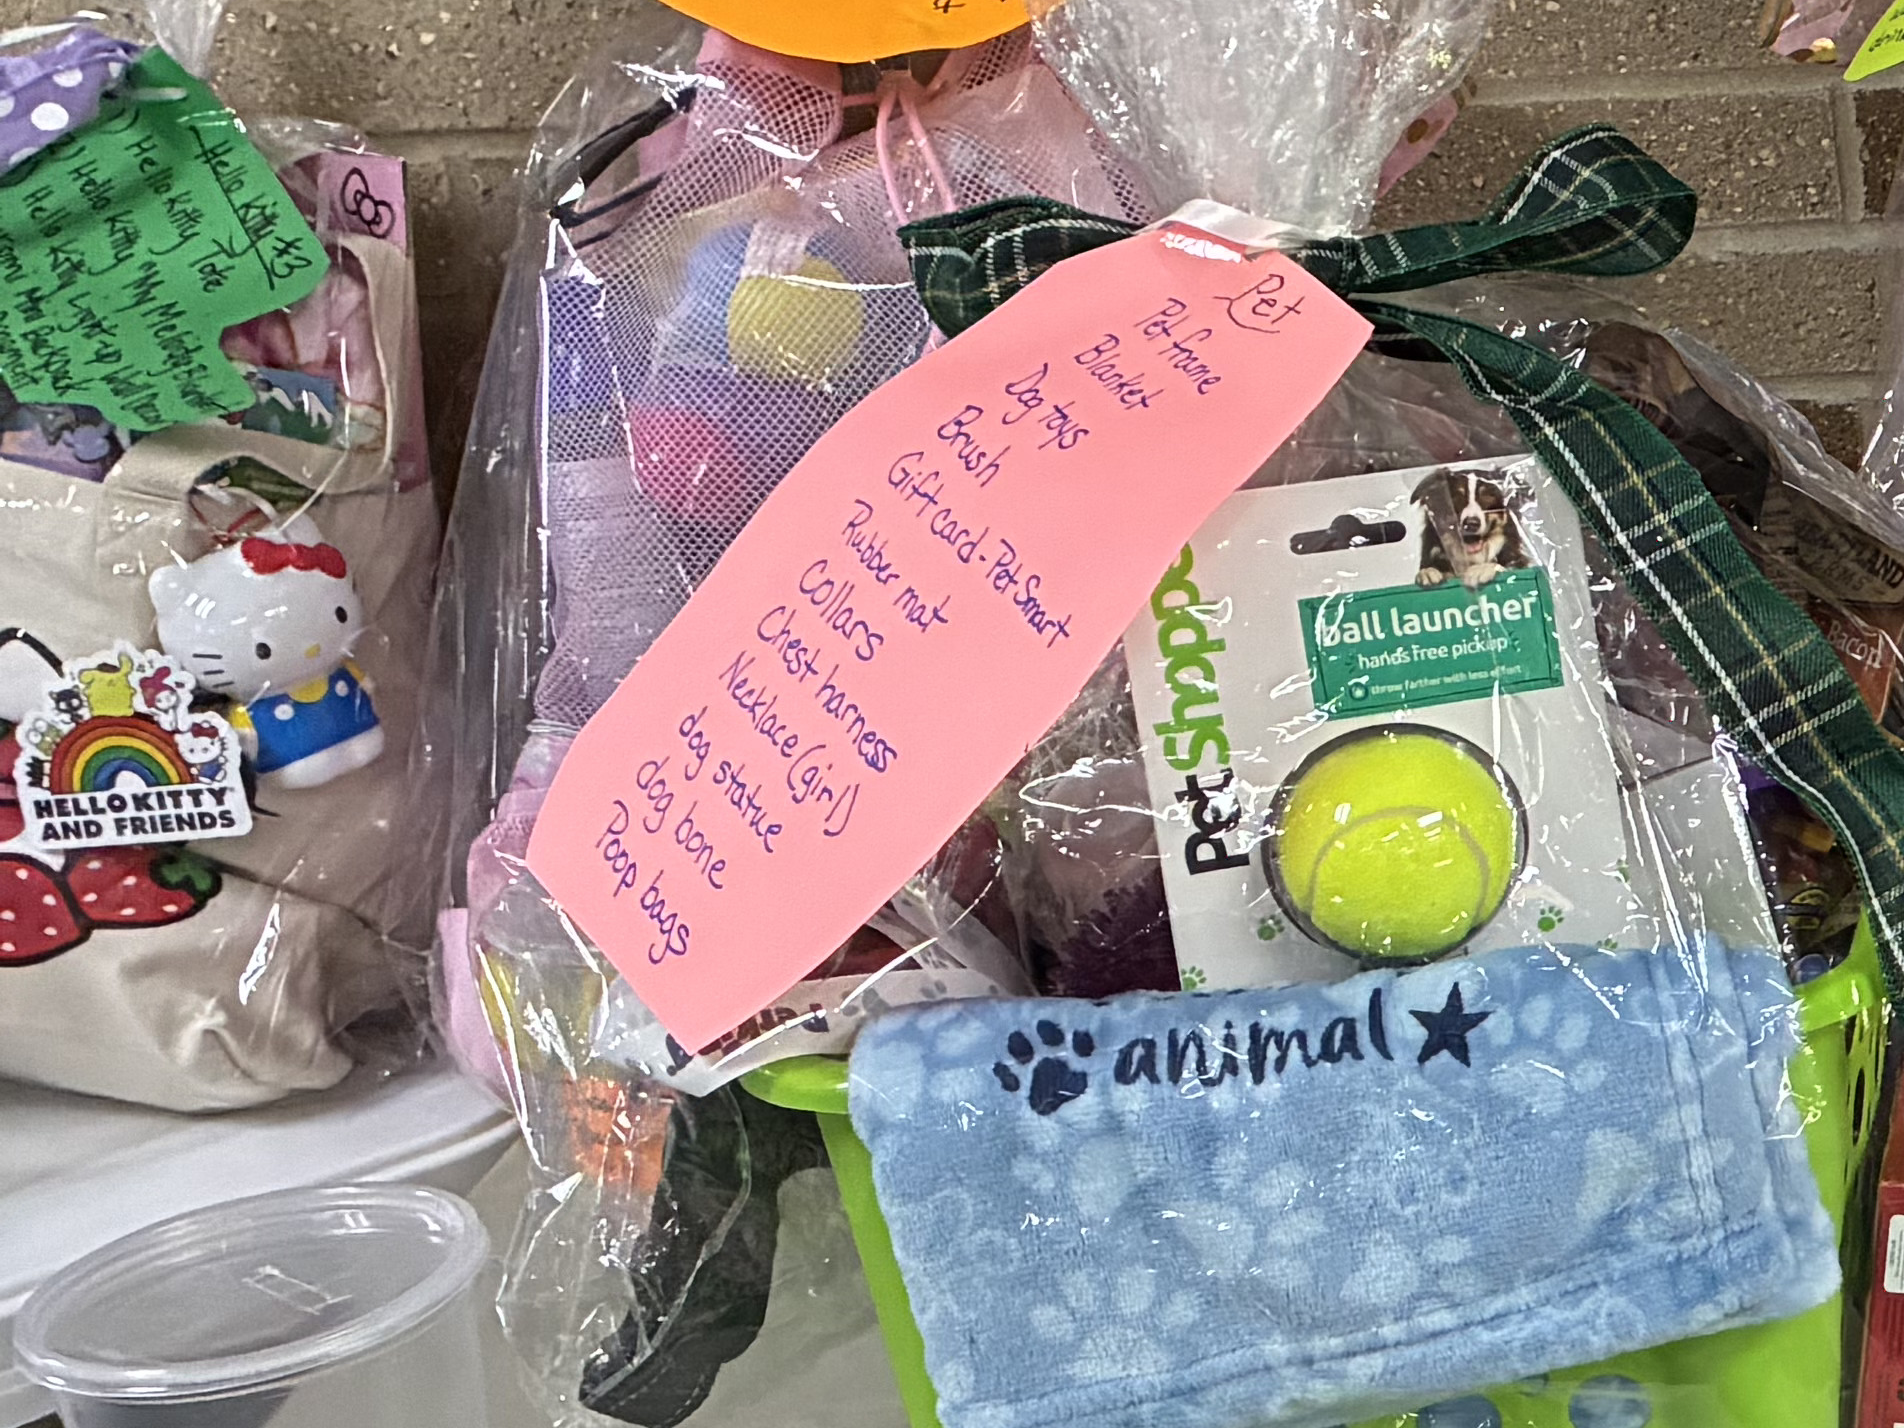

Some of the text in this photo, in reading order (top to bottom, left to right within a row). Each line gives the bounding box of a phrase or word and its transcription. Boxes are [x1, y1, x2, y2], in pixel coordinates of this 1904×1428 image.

[71, 161, 122, 217] Hello
[124, 134, 175, 196] Hello
[196, 138, 247, 200] Hello
[128, 189, 205, 256] Kitty
[1234, 273, 1305, 334] Pet
[1073, 333, 1165, 411] Blanket
[1133, 297, 1222, 396] Pet frame
[1001, 362, 1090, 451] Dog toys
[887, 450, 945, 517] Gift
[936, 404, 1011, 488] Brush
[841, 498, 951, 634] Rubber mat
[1320, 592, 1538, 650] ball launcher
[1411, 643, 1450, 665] free
[718, 650, 861, 838] Necklace (girl)
[814, 668, 898, 774] harness
[33, 787, 227, 819] HELLO KITTY
[665, 705, 783, 854] dog statue
[42, 810, 236, 842] AND FRIENDS
[615, 760, 726, 890] dog bone
[595, 799, 690, 966] Poop bags
[1115, 989, 1392, 1088] animal
